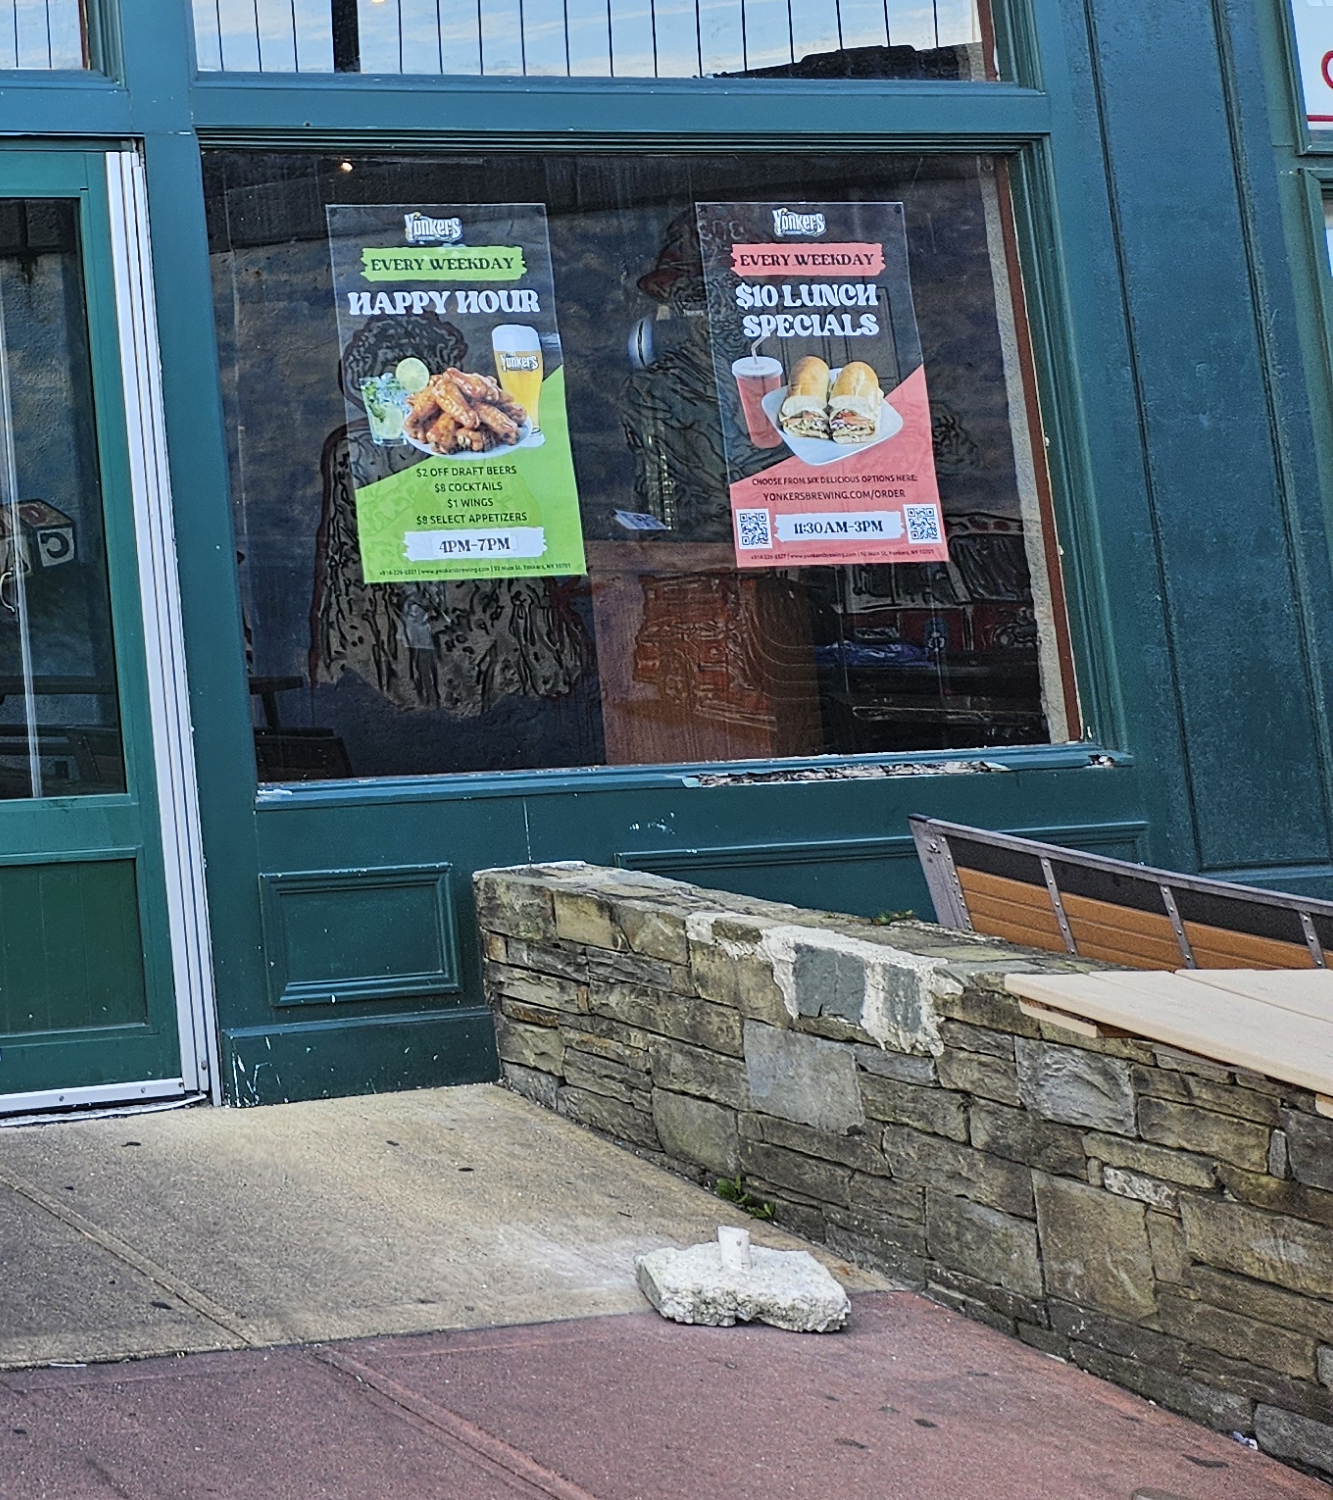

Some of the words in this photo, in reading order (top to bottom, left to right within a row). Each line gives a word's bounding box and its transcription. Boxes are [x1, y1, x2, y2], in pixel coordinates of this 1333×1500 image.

[404, 212, 463, 243] Yonkers
[772, 207, 827, 237] Yonkers
[371, 258, 425, 271] EVERY
[430, 257, 515, 270] WEEKDAY
[739, 254, 791, 267] EVERY
[794, 253, 874, 266] WEEKDAY
[347, 290, 451, 315] HAPPY
[455, 289, 540, 314] HOUR
[735, 282, 779, 310] $10
[781, 283, 879, 307] LUNCH
[743, 313, 880, 337] SPECIALS
[416, 468, 428, 478] $2
[430, 467, 449, 477] OFF
[451, 466, 484, 476] DRAFT
[486, 465, 517, 476] BEERS
[434, 483, 446, 493] $8
[448, 481, 503, 492] COCKTAILS
[752, 477, 782, 486] CHOOSE
[783, 476, 806, 485] FROM
[807, 476, 819, 484] SIX
[820, 475, 860, 485] DELICIOUS
[861, 475, 895, 483] OPTIONS
[762, 489, 906, 501] YONKERSBREWING.COM/ORDER
[447, 499, 459, 508] $1
[460, 498, 494, 508] WINGS
[430, 514, 466, 525] SELECT
[468, 512, 528, 523] APPETIZERS
